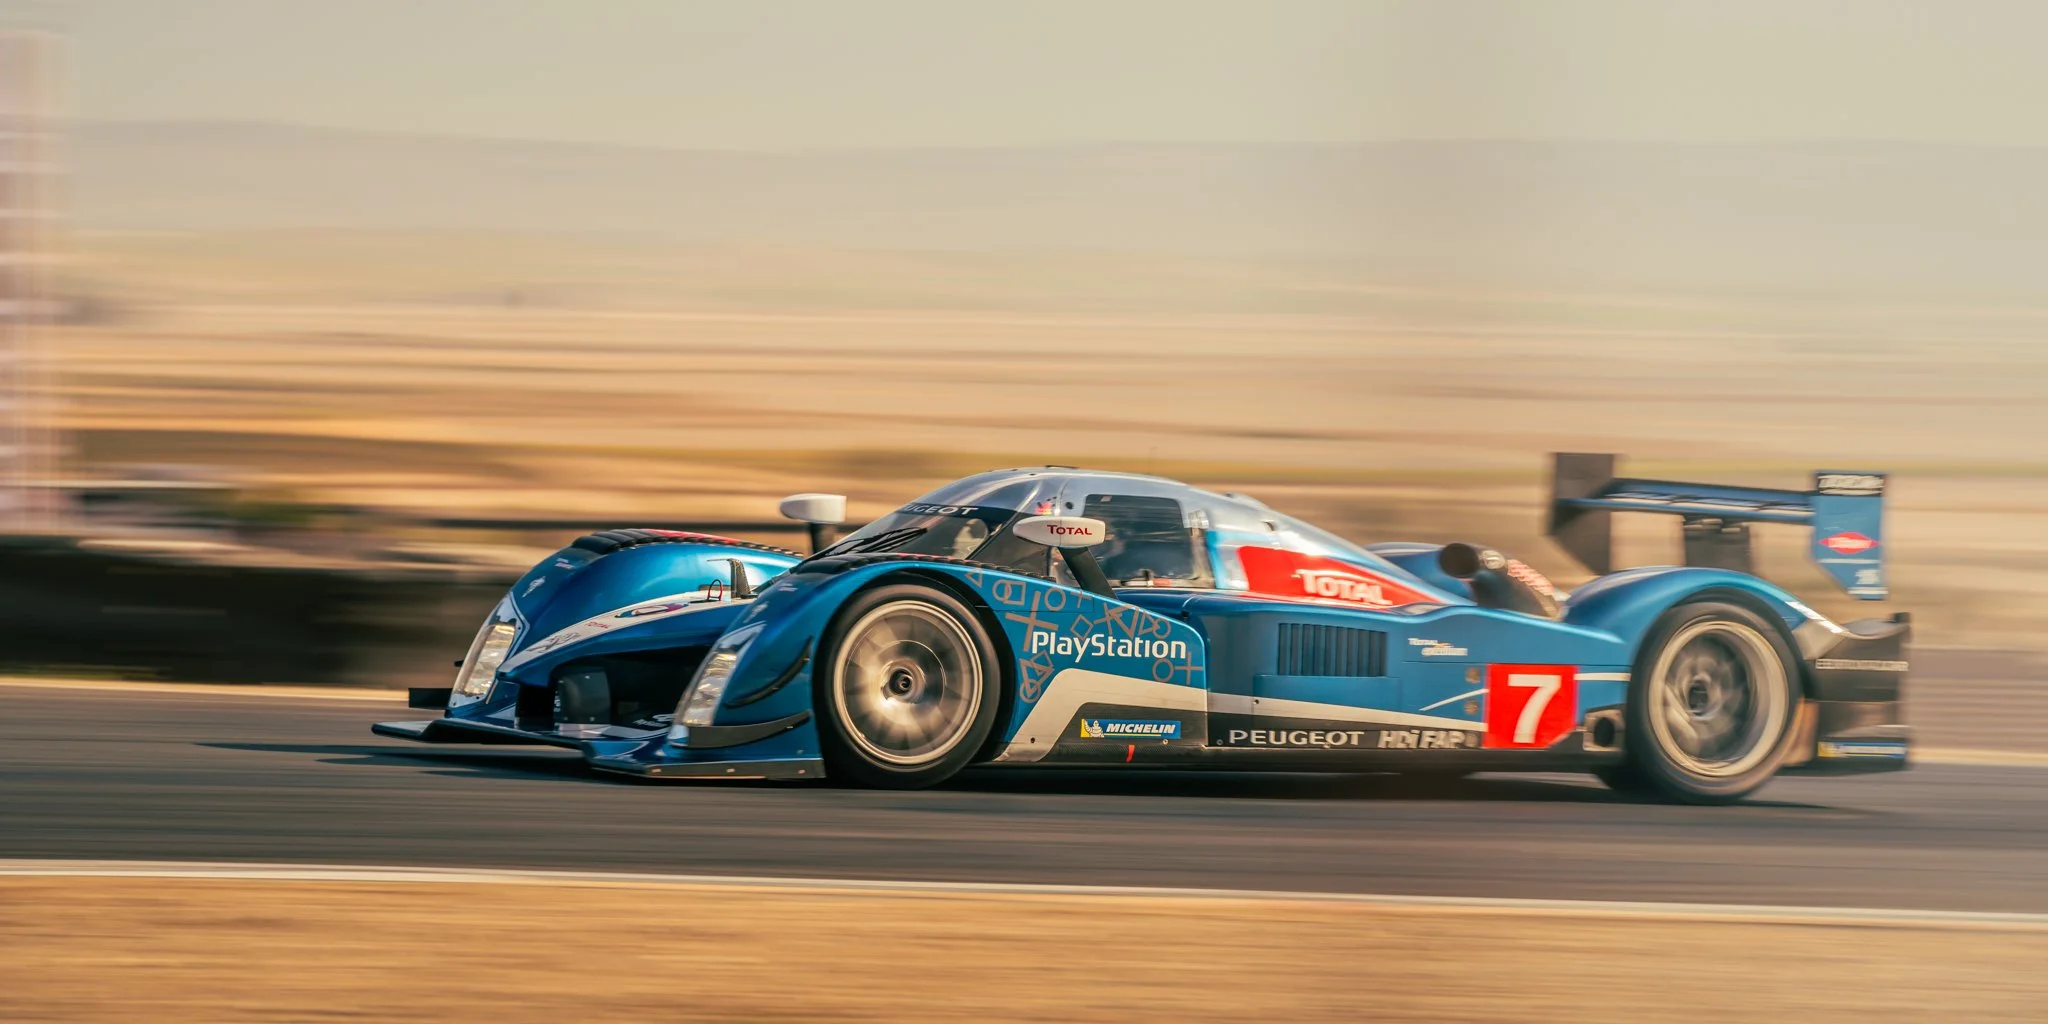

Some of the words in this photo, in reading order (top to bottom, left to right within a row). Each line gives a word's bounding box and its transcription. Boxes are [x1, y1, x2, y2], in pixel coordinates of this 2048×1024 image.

[903, 504, 979, 515] UGEOT
[1046, 524, 1093, 535] TOTAL
[1296, 569, 1393, 605] TOTAL
[1032, 631, 1187, 663] PlayStation
[1507, 674, 1562, 744] 7
[1106, 723, 1176, 734] MICHELIN
[1229, 730, 1364, 746] PEUGEOT
[1419, 730, 1466, 749] FAP
